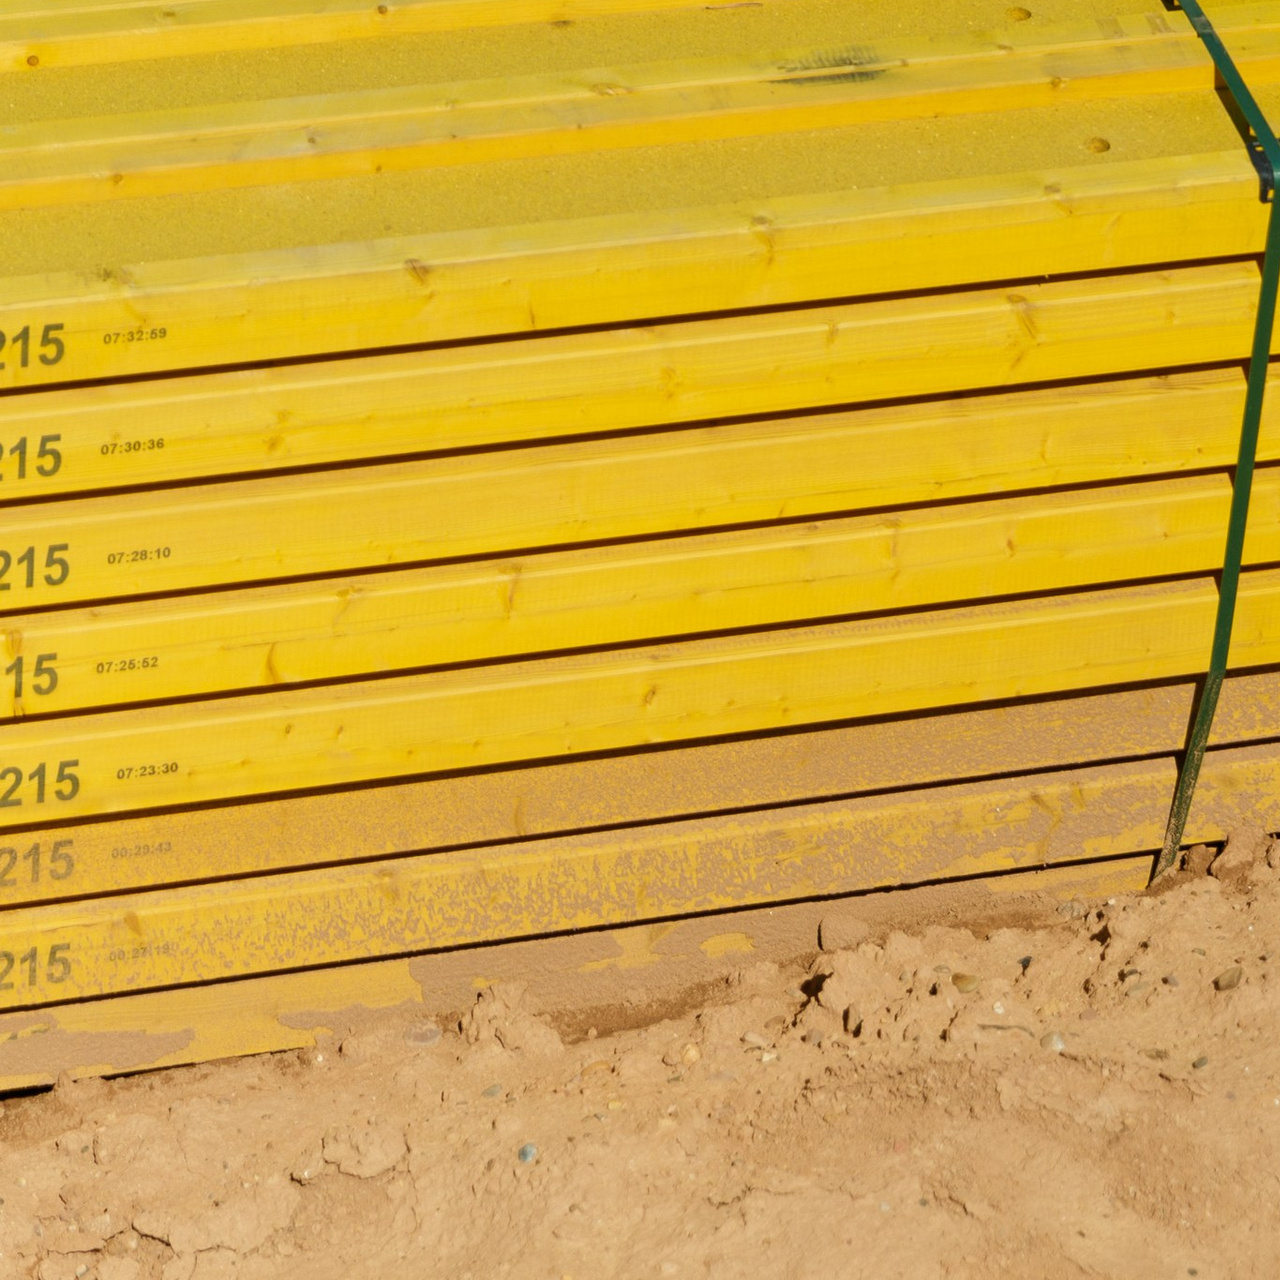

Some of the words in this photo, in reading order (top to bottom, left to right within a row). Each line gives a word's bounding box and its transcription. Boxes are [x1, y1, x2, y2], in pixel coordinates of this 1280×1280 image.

[0, 323, 65, 370] 15
[103, 328, 167, 345] 07:32:59
[0, 434, 62, 482] 15
[101, 438, 165, 455] 07:30:36
[107, 547, 171, 565] 07:28:10
[96, 656, 159, 674] 07:25:52
[0, 759, 80, 808] 215
[116, 762, 179, 780] 07:23:30
[0, 839, 75, 887] 215
[0, 942, 71, 990] 215
